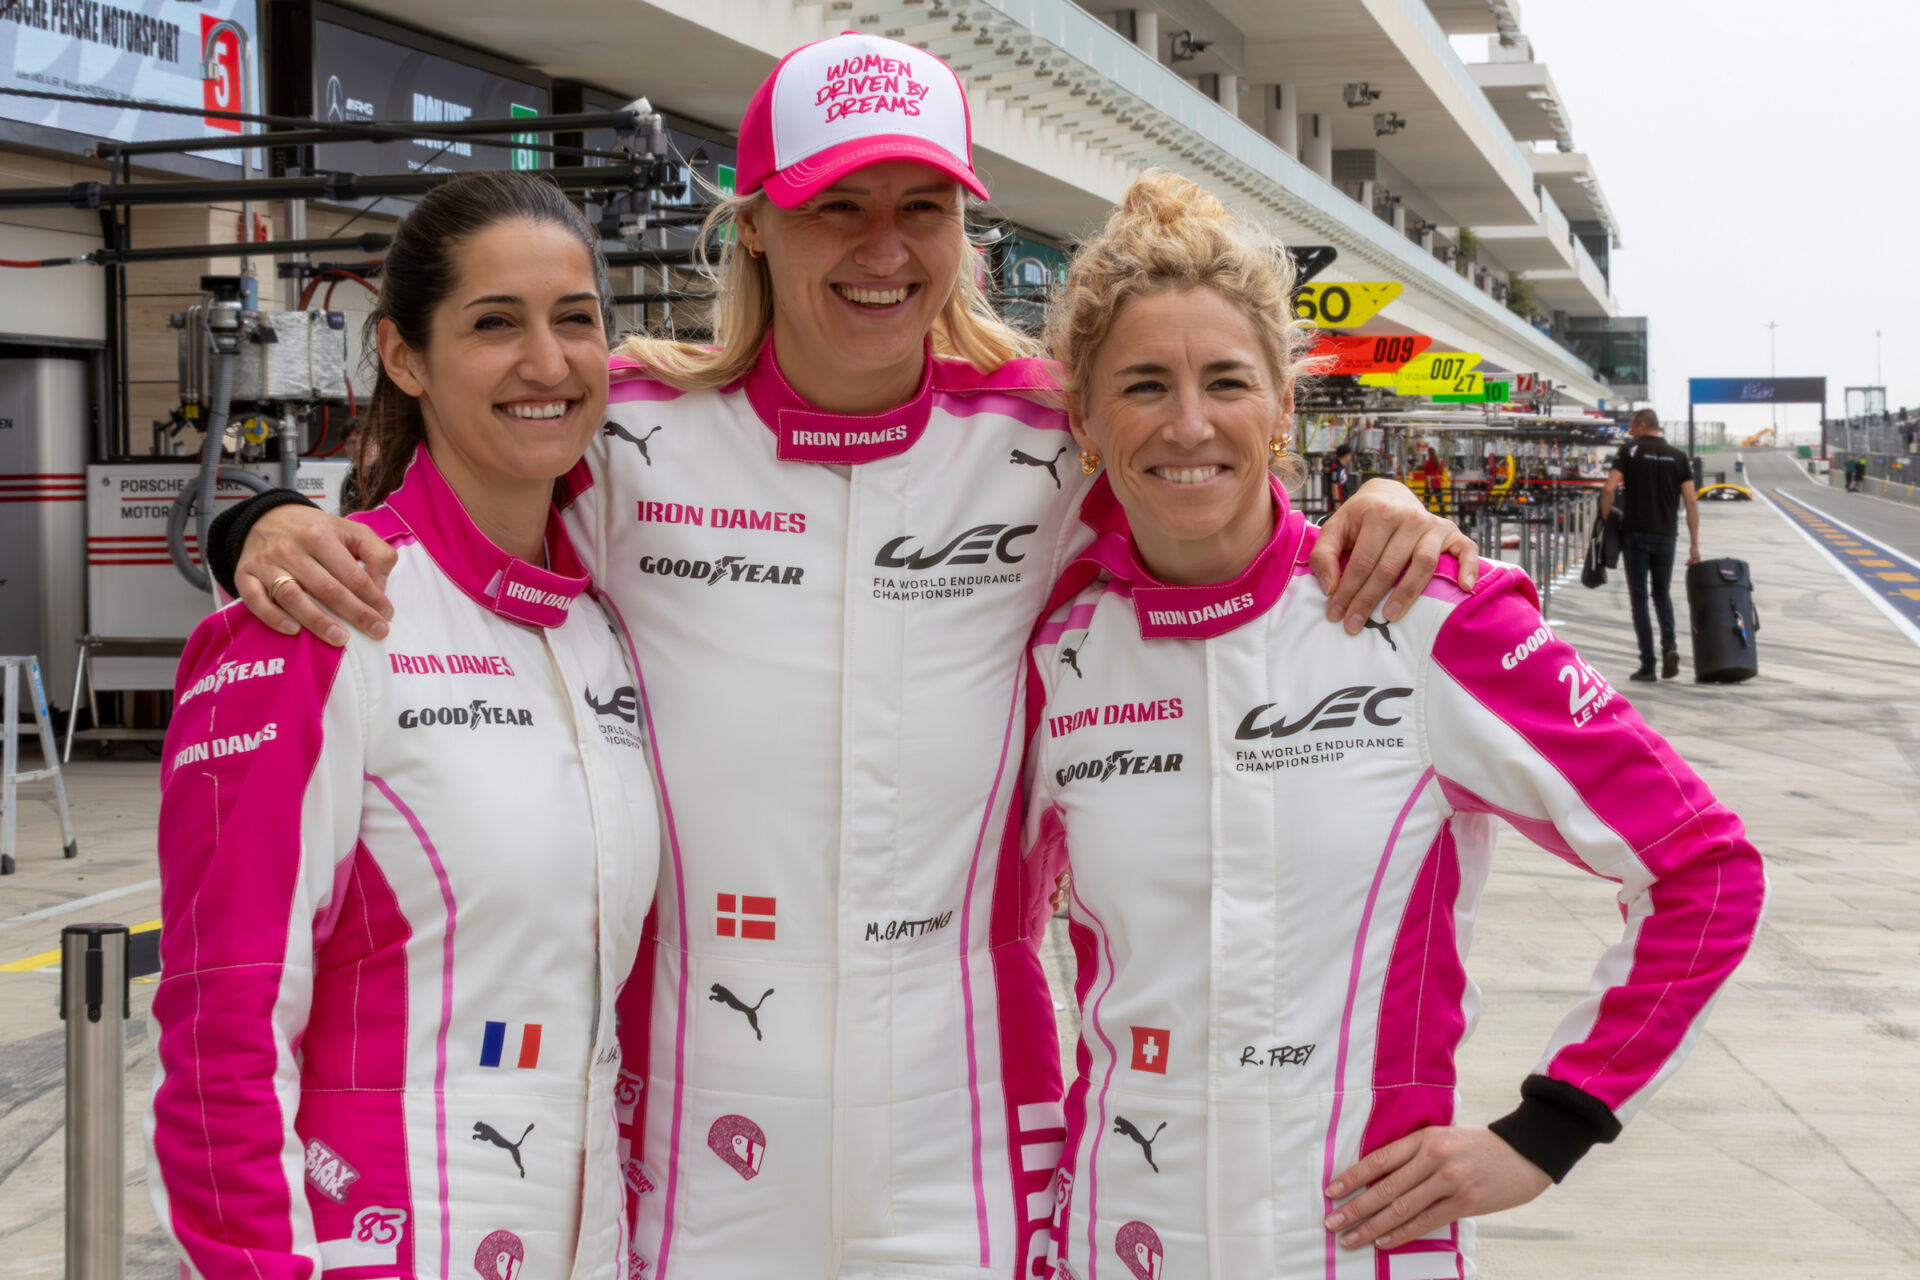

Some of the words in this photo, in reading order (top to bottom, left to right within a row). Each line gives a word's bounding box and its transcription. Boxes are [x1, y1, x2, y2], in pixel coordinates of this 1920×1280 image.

[101, 4, 180, 63] MOTORSPORT
[213, 41, 230, 108] 5
[826, 54, 912, 82] WOMEN
[815, 75, 899, 107] DRIVEN
[905, 80, 929, 101] BY
[825, 95, 920, 123] DREAMS
[1293, 285, 1352, 324] 60
[1374, 337, 1415, 364] 009
[1430, 358, 1466, 381] 007
[1453, 373, 1477, 393] 27
[1520, 374, 1531, 391] 7
[1485, 383, 1503, 401] 10
[792, 430, 841, 447] IRON
[844, 425, 908, 446] DAMES
[120, 479, 185, 492] PORSCHE
[637, 500, 704, 526] IRON
[710, 508, 807, 534] DAMES
[874, 523, 1039, 570] WEC
[639, 555, 805, 587] GOODYEAR
[873, 577, 896, 589] FIA
[899, 576, 947, 590] WORLD
[950, 573, 1022, 587] ENDURANCE
[507, 581, 547, 605] IRON
[873, 587, 974, 601] CHAMPIONSHIP
[1148, 610, 1188, 626] IRON
[1188, 592, 1255, 625] DAMES
[388, 652, 446, 675] IRON
[445, 654, 516, 677] DAMES
[398, 699, 535, 732] GOODYEAR
[1048, 706, 1100, 738] IRON
[1103, 697, 1184, 725] DAMES
[1235, 685, 1415, 740] WEC
[1573, 706, 1593, 729] LE
[212, 722, 278, 759] DAMS
[598, 724, 625, 736] ORLD
[1235, 752, 1345, 773] CHAMPIONSHIP
[1236, 750, 1258, 761] FIA
[1261, 743, 1312, 760] WORLD
[1315, 737, 1405, 752] ENDURANCE
[1055, 749, 1184, 788] GOODYEAR
[864, 910, 953, 942] M.GATTING
[306, 1141, 355, 1188] STAY
[356, 1211, 403, 1246] 85
